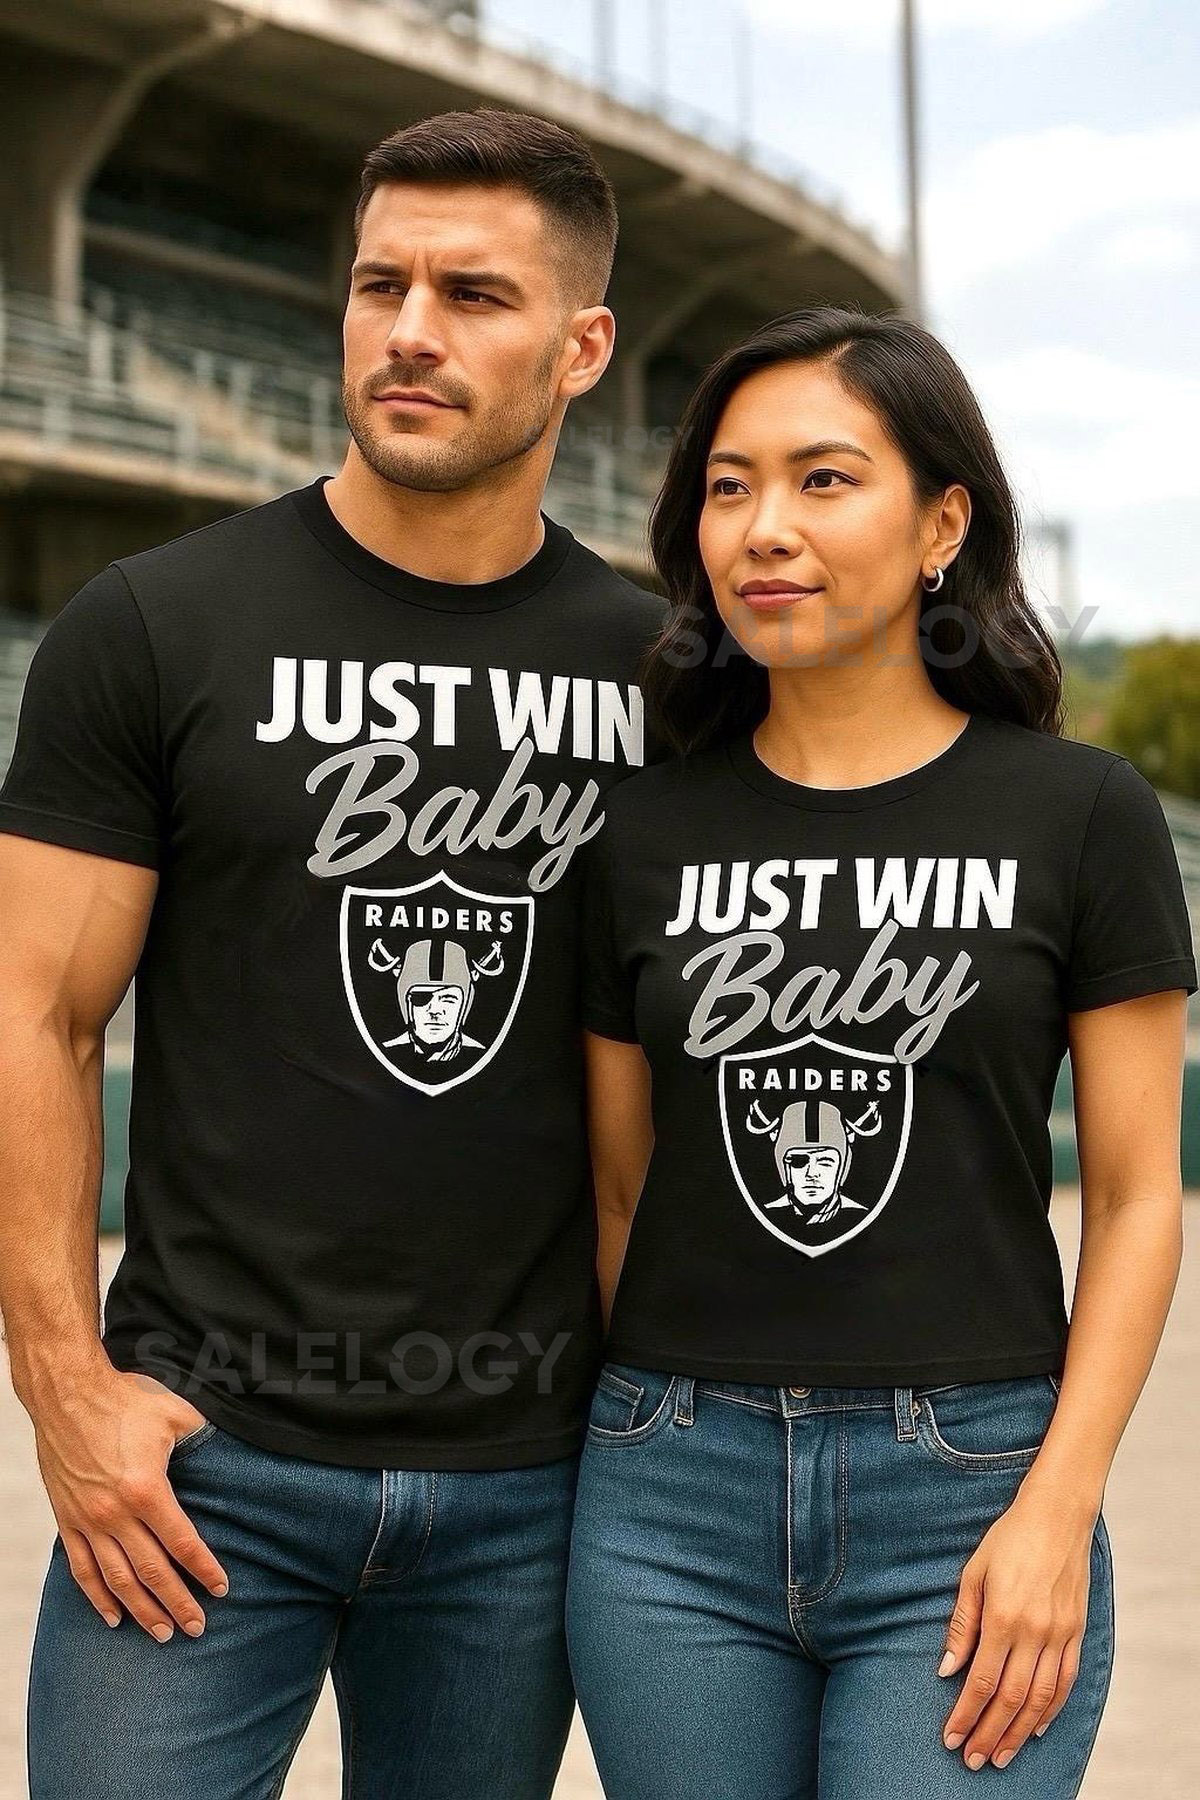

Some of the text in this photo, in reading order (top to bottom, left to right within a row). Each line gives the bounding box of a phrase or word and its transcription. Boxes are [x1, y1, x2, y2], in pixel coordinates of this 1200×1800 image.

[255, 656, 645, 767] JUST WIN
[305, 736, 606, 893] Baby
[365, 904, 514, 933] RAIDERS
[665, 857, 1018, 937] JUST WIN
[681, 918, 980, 1065] Baby
[738, 1068, 892, 1092] RAIDERS
